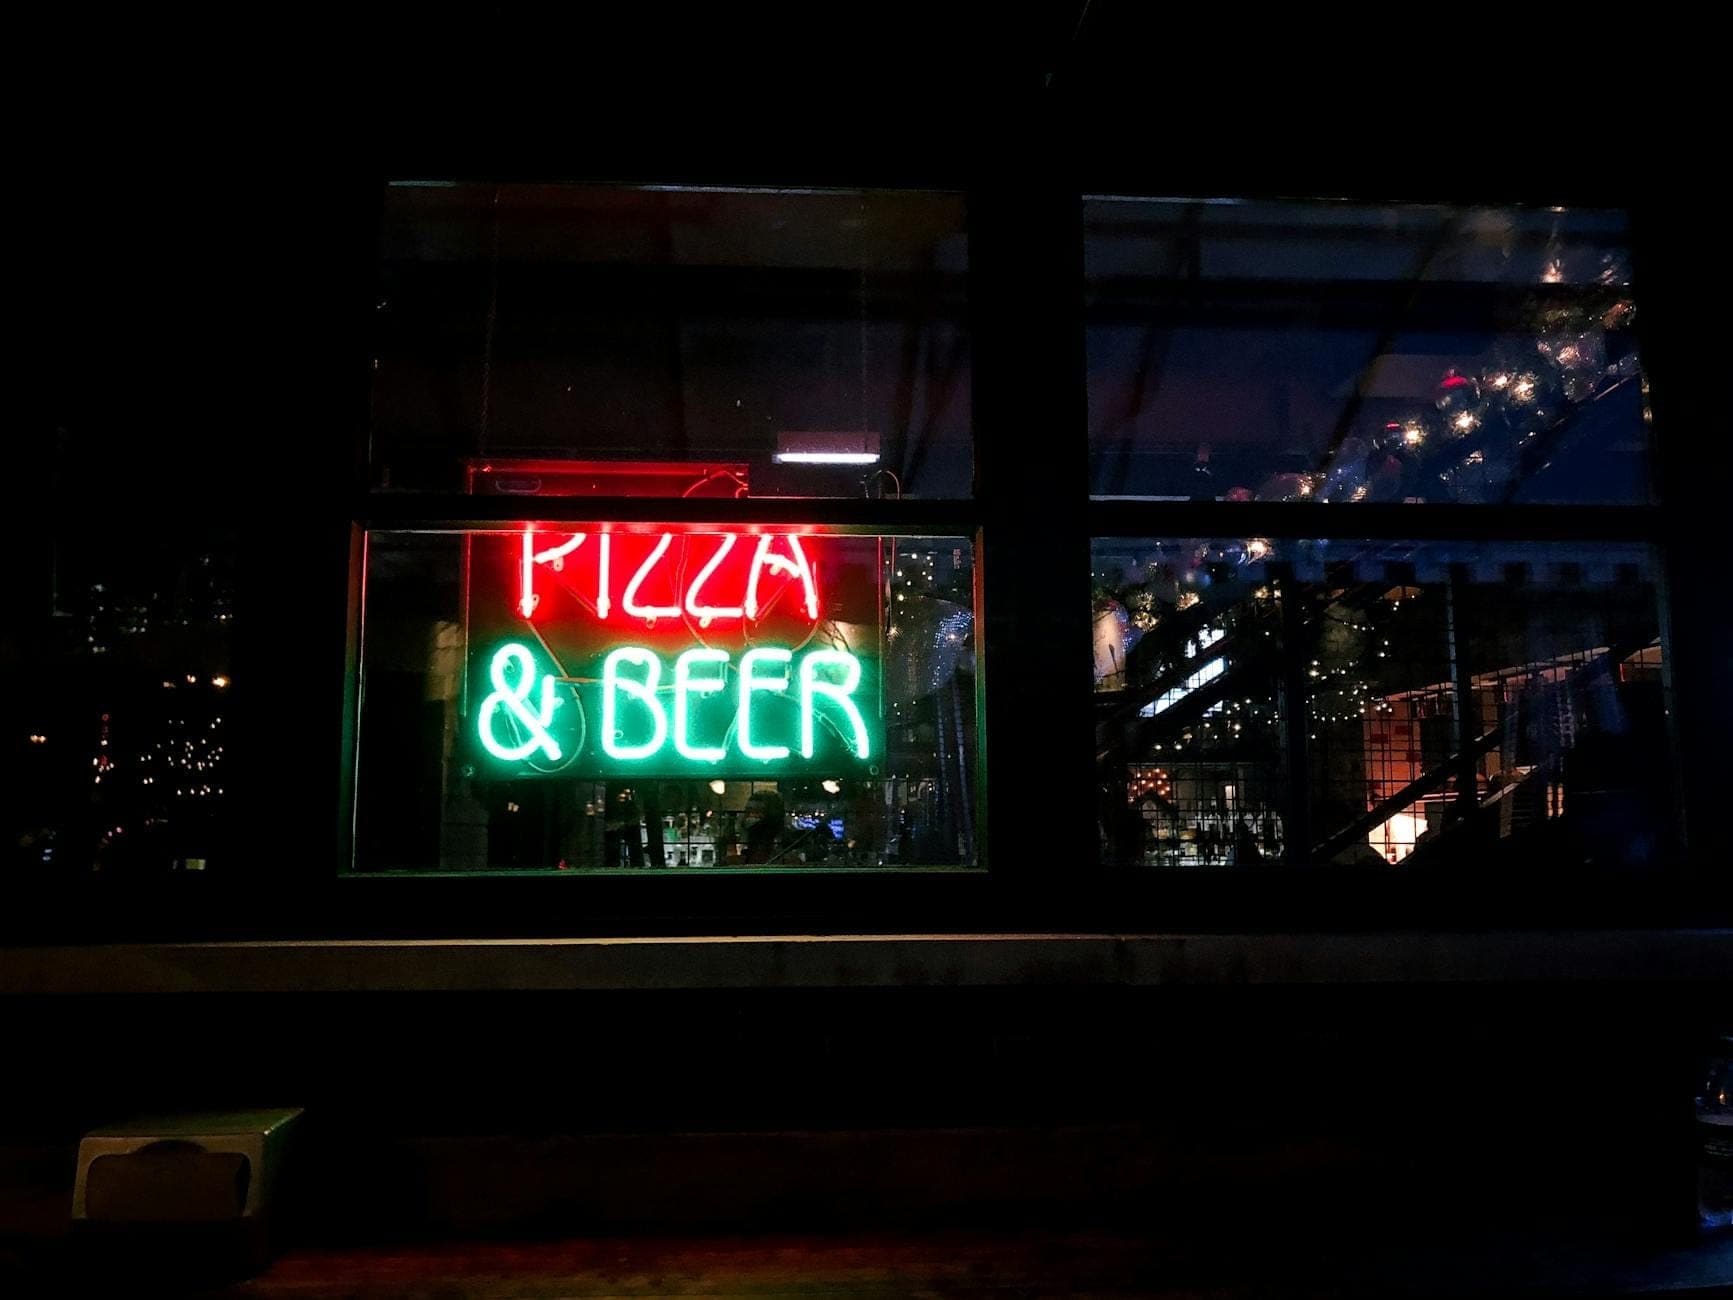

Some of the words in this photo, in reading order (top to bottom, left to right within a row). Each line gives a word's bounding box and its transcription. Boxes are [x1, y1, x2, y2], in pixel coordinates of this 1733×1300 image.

[521, 532, 819, 618] PIZZA
[478, 643, 563, 761] &
[602, 646, 870, 761] BEER
